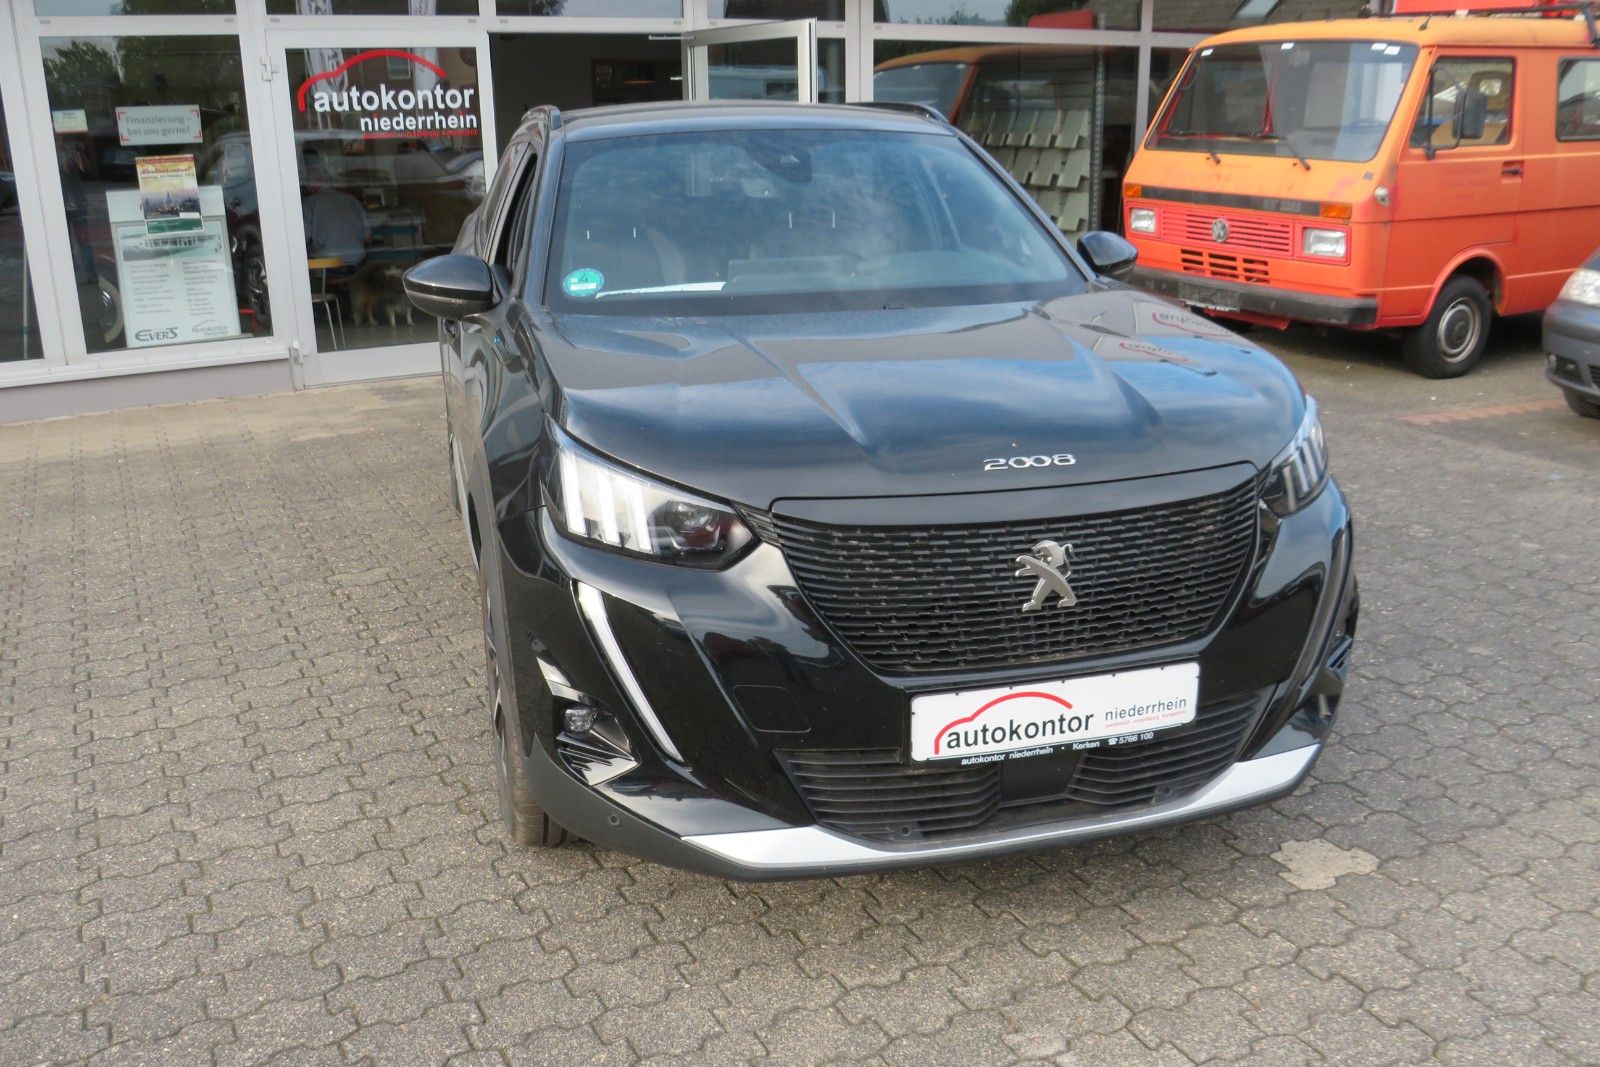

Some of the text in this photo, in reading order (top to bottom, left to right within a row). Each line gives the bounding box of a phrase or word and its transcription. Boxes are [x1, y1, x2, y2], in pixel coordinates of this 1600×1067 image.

[314, 84, 475, 112] autokontor
[126, 115, 186, 126] Finanzierung
[127, 126, 142, 136] bei
[143, 127, 160, 136] uns
[360, 111, 478, 132] niederrhein
[983, 453, 1076, 472] 2008
[1104, 697, 1188, 722] niederrhein
[946, 711, 1095, 750] autokontor
[960, 732, 1154, 766] autokontor niederrhein Kerken 5766 100
